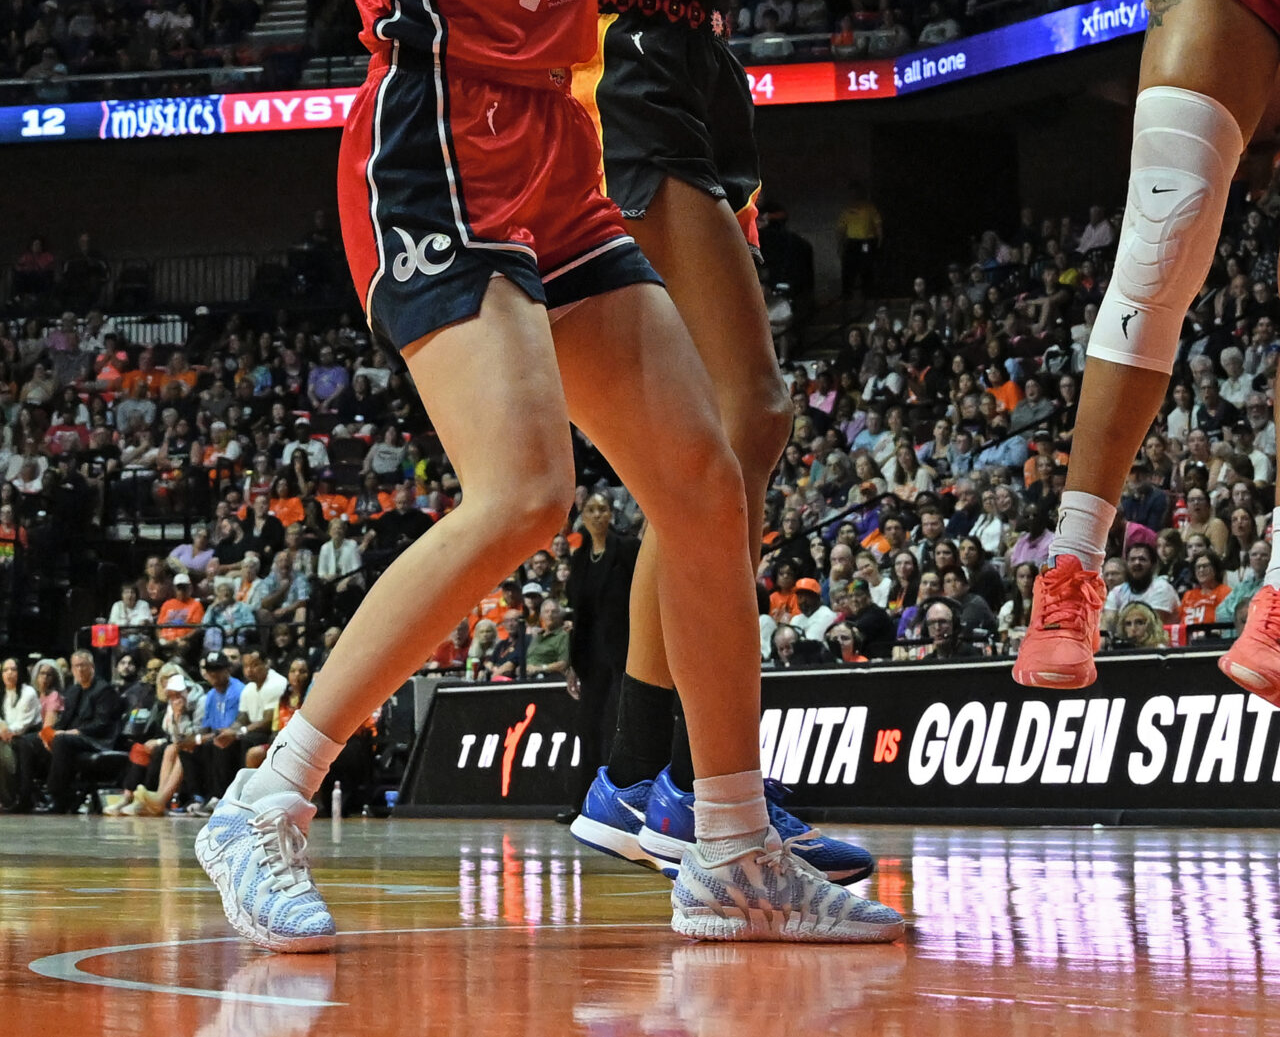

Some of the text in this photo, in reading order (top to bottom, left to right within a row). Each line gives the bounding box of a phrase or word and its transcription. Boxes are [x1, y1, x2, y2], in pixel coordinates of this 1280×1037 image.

[1082, 1, 1138, 38] xfinity
[847, 70, 879, 92] 1st
[903, 59, 922, 84] all
[922, 57, 937, 77] in
[937, 51, 967, 76] one
[21, 107, 66, 137] 12
[873, 728, 902, 763] VS
[907, 698, 1126, 786] GOLDEN
